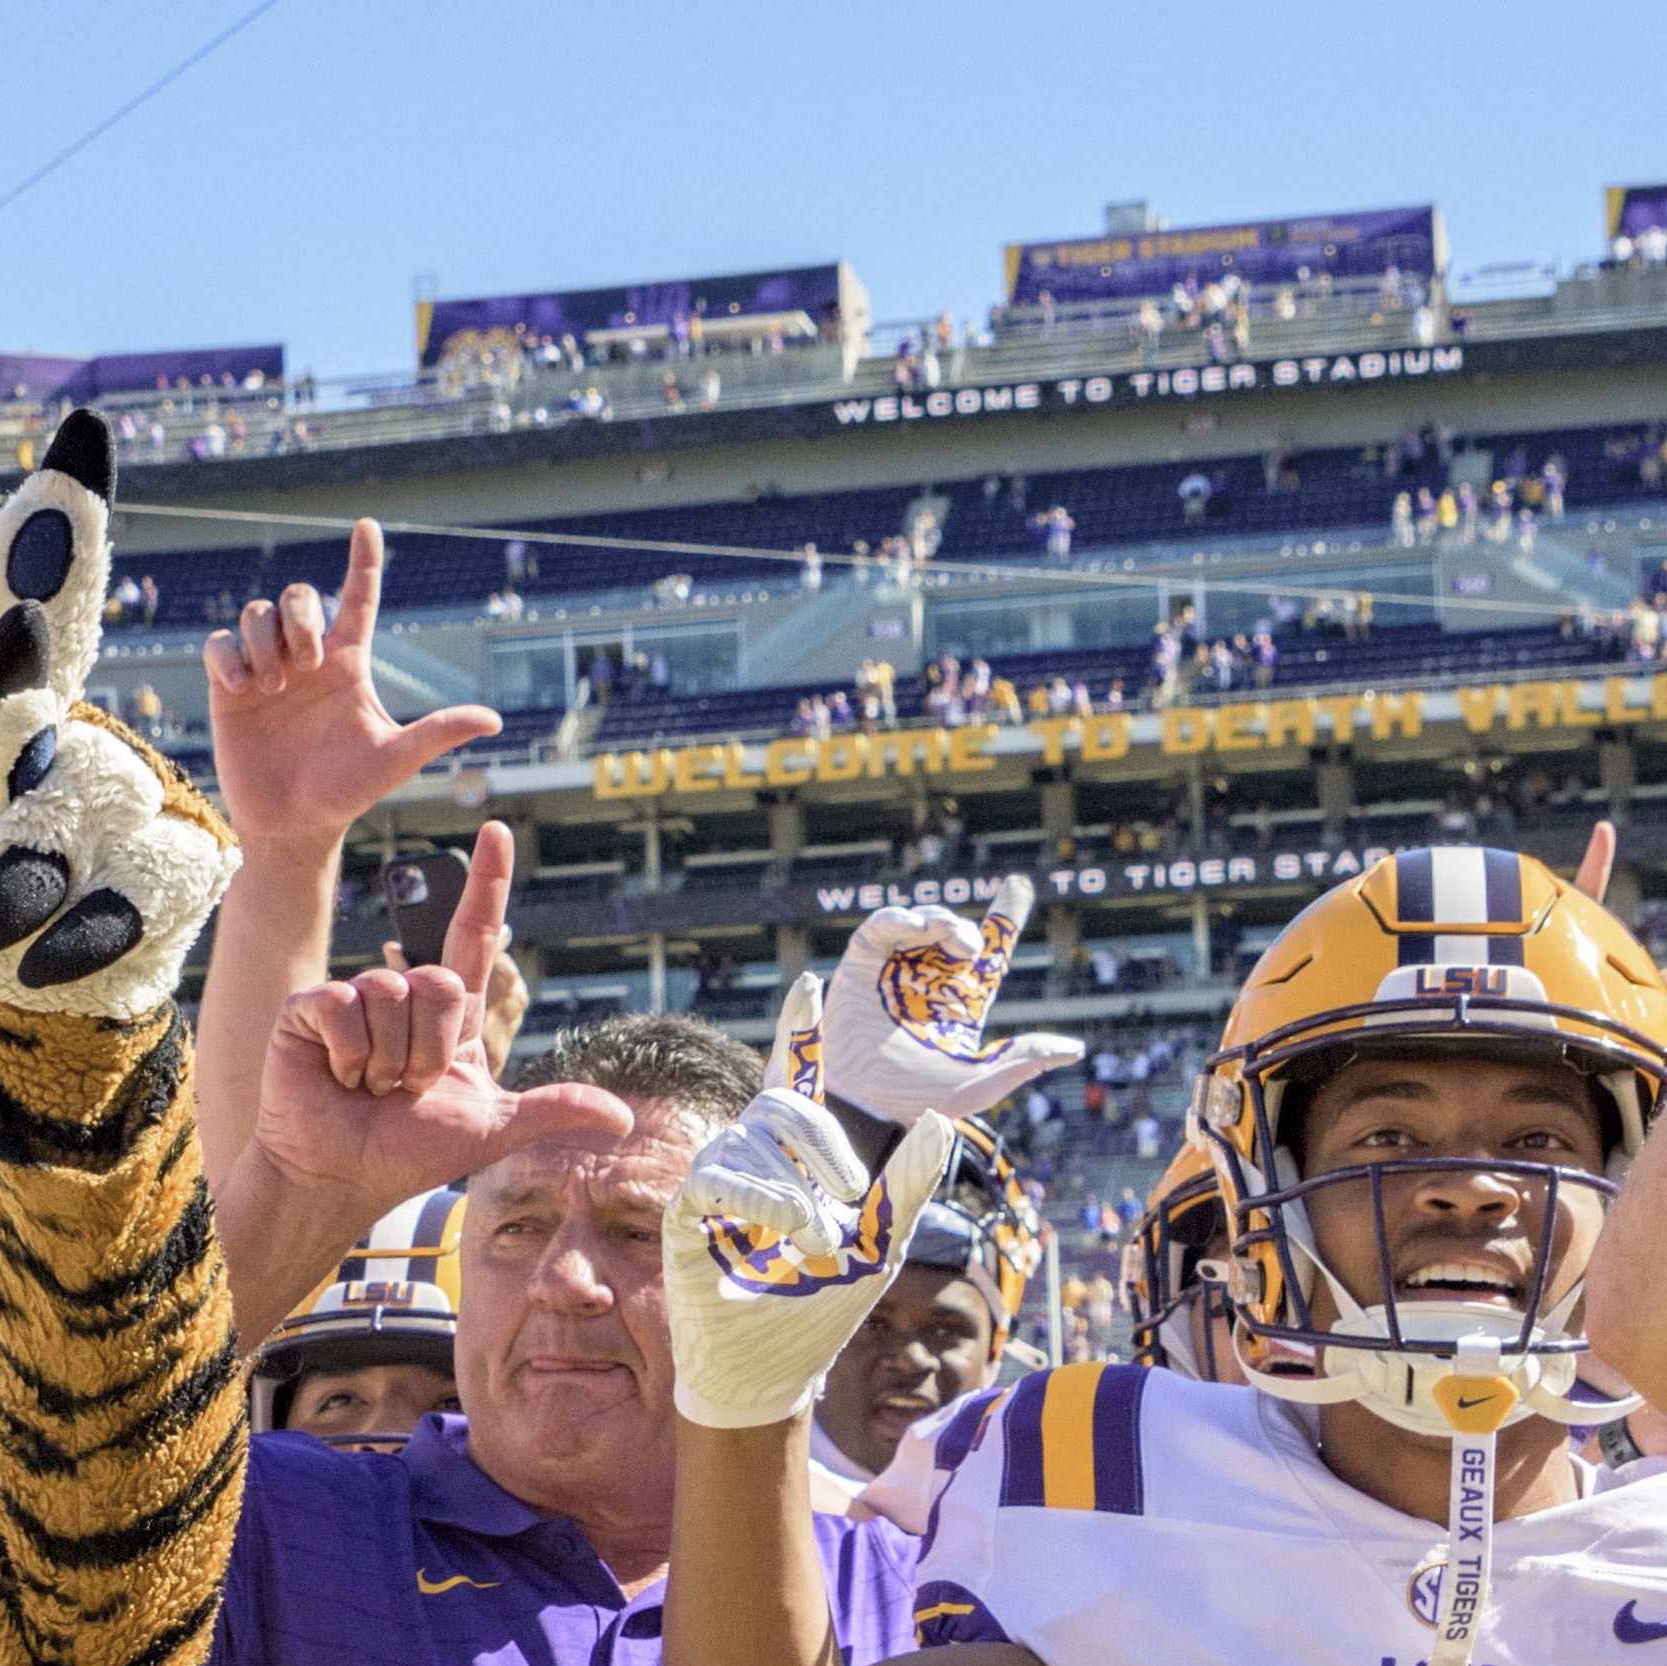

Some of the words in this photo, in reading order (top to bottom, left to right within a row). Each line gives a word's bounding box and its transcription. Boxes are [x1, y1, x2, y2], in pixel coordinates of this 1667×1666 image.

[1056, 240, 1132, 267] TIGER
[1139, 228, 1259, 259] STADIUM
[834, 383, 1041, 426] WELCOME
[1059, 377, 1113, 404] TO
[1128, 363, 1258, 398] TIGER
[1272, 346, 1464, 388] STADIUM
[592, 725, 997, 800] WELCOME
[1029, 711, 1132, 765] TO
[1161, 690, 1424, 755] DEATH
[817, 876, 1007, 913] WELCOM
[1050, 867, 1107, 896] TO
[1125, 856, 1256, 891] TIGER
[1273, 843, 1422, 880] STAD
[1415, 967, 1508, 994] LSU
[342, 1280, 415, 1304] LSU
[1458, 1448, 1486, 1542] GEAUX
[1445, 1555, 1483, 1641] TIGERS
